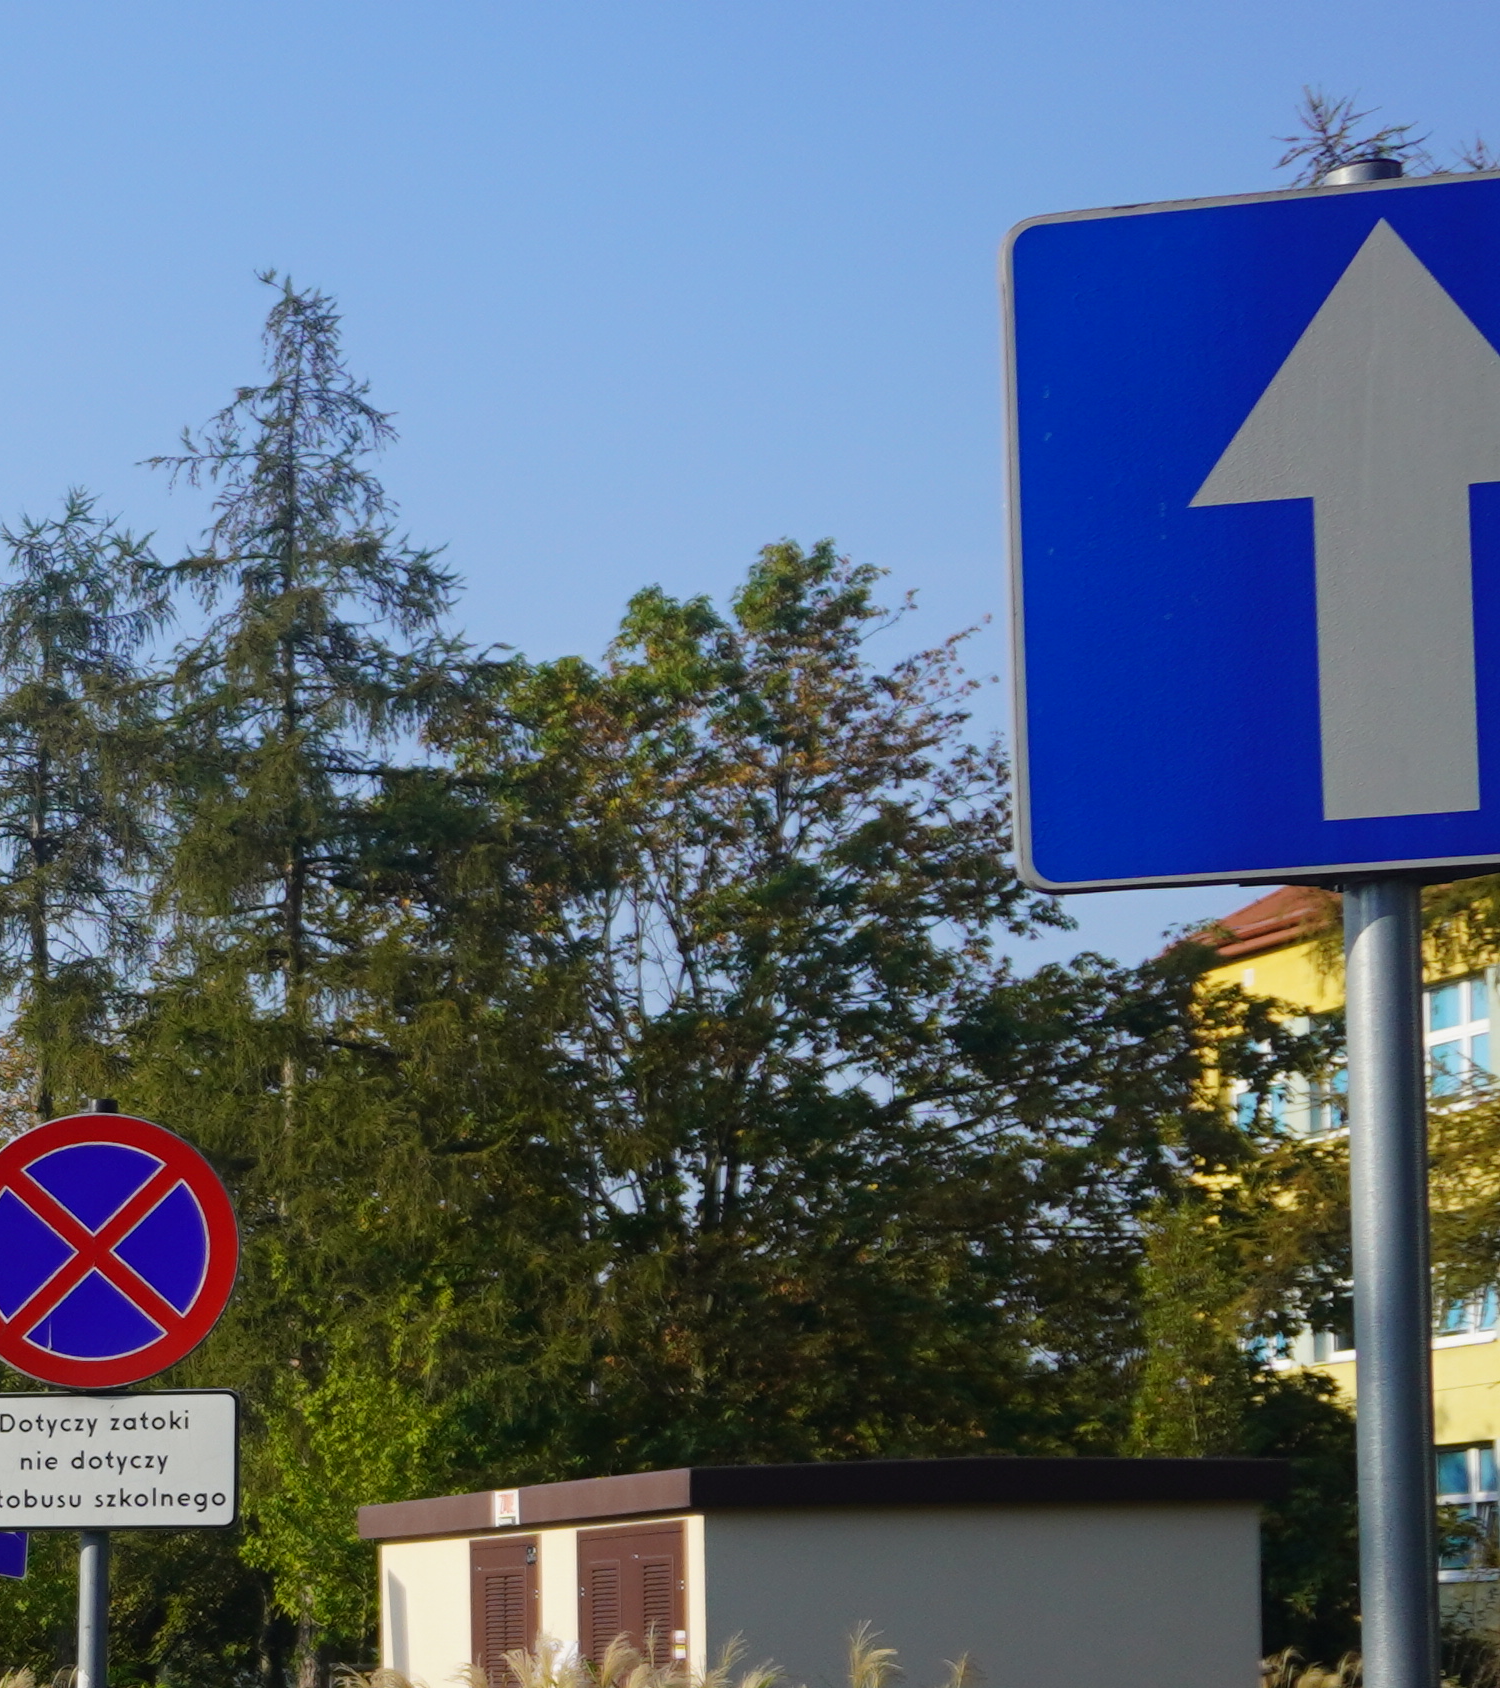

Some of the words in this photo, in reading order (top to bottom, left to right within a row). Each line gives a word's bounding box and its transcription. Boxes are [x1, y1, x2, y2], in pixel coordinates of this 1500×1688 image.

[0, 1413, 98, 1438] Dotyczy
[110, 1410, 190, 1431] zatoki
[20, 1451, 58, 1470] nie
[71, 1450, 169, 1475] dotyczy
[95, 1487, 227, 1512] szkolnego
